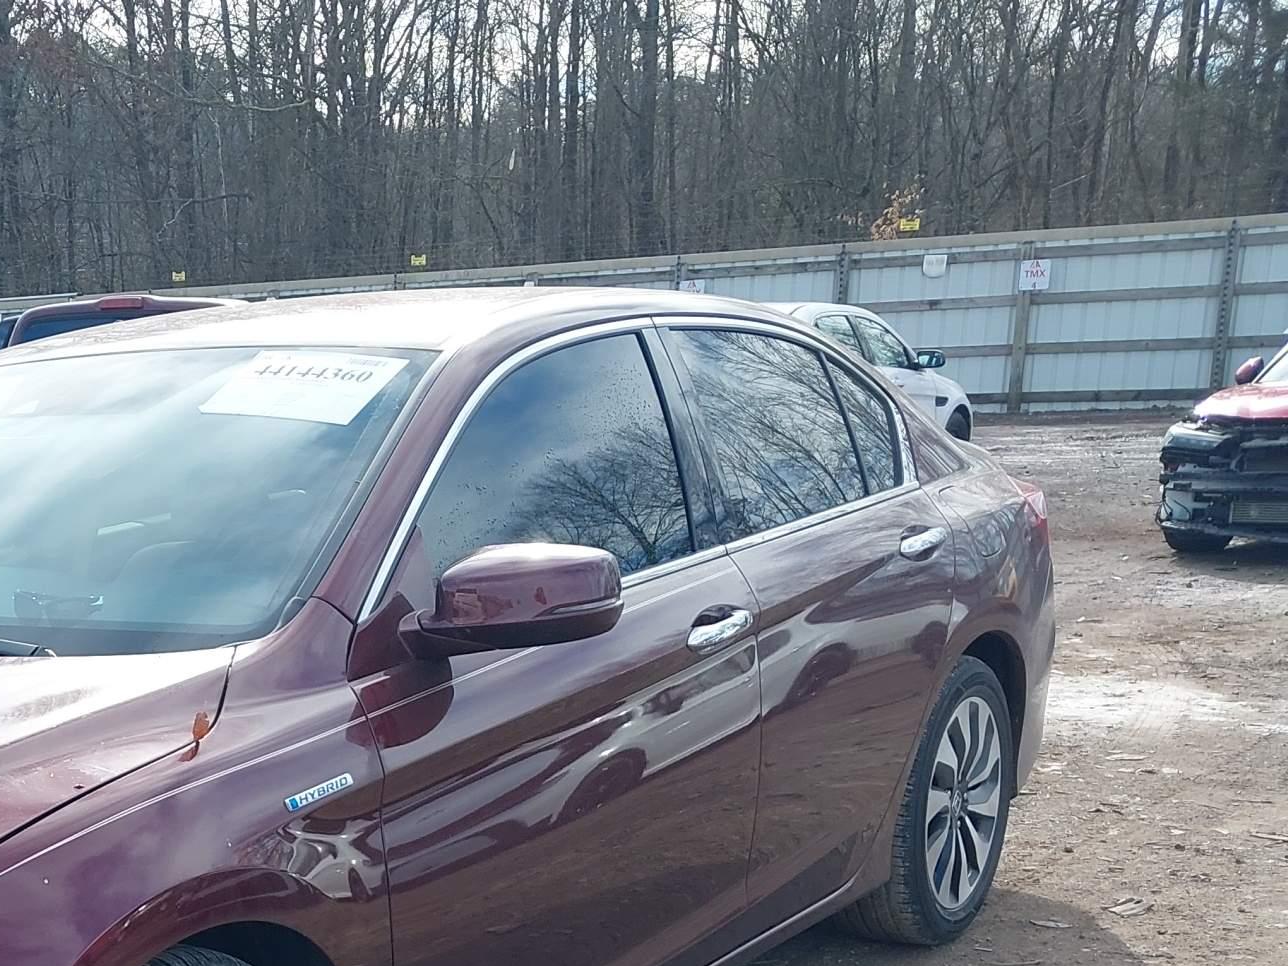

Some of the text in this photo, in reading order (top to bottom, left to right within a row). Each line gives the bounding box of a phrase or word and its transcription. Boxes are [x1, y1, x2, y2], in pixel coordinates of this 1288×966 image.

[1024, 270, 1046, 278] TMX
[254, 364, 374, 383] 44144360
[298, 776, 348, 805] HYBRID
